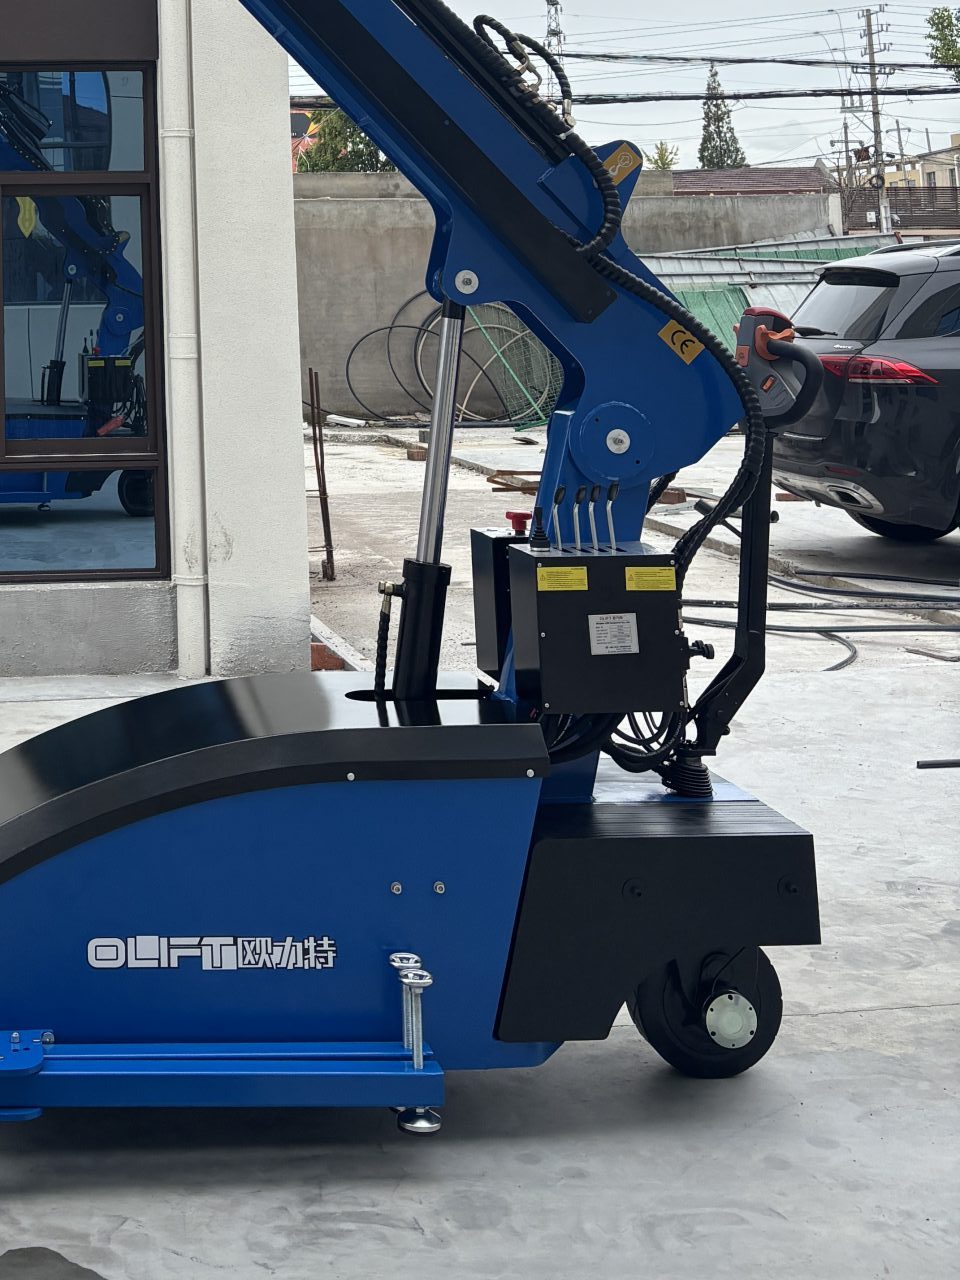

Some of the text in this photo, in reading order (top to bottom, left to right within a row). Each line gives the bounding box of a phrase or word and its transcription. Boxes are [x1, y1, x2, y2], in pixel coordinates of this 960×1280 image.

[671, 330, 695, 355] CE
[87, 935, 337, 970] OLIFT 欧力特
